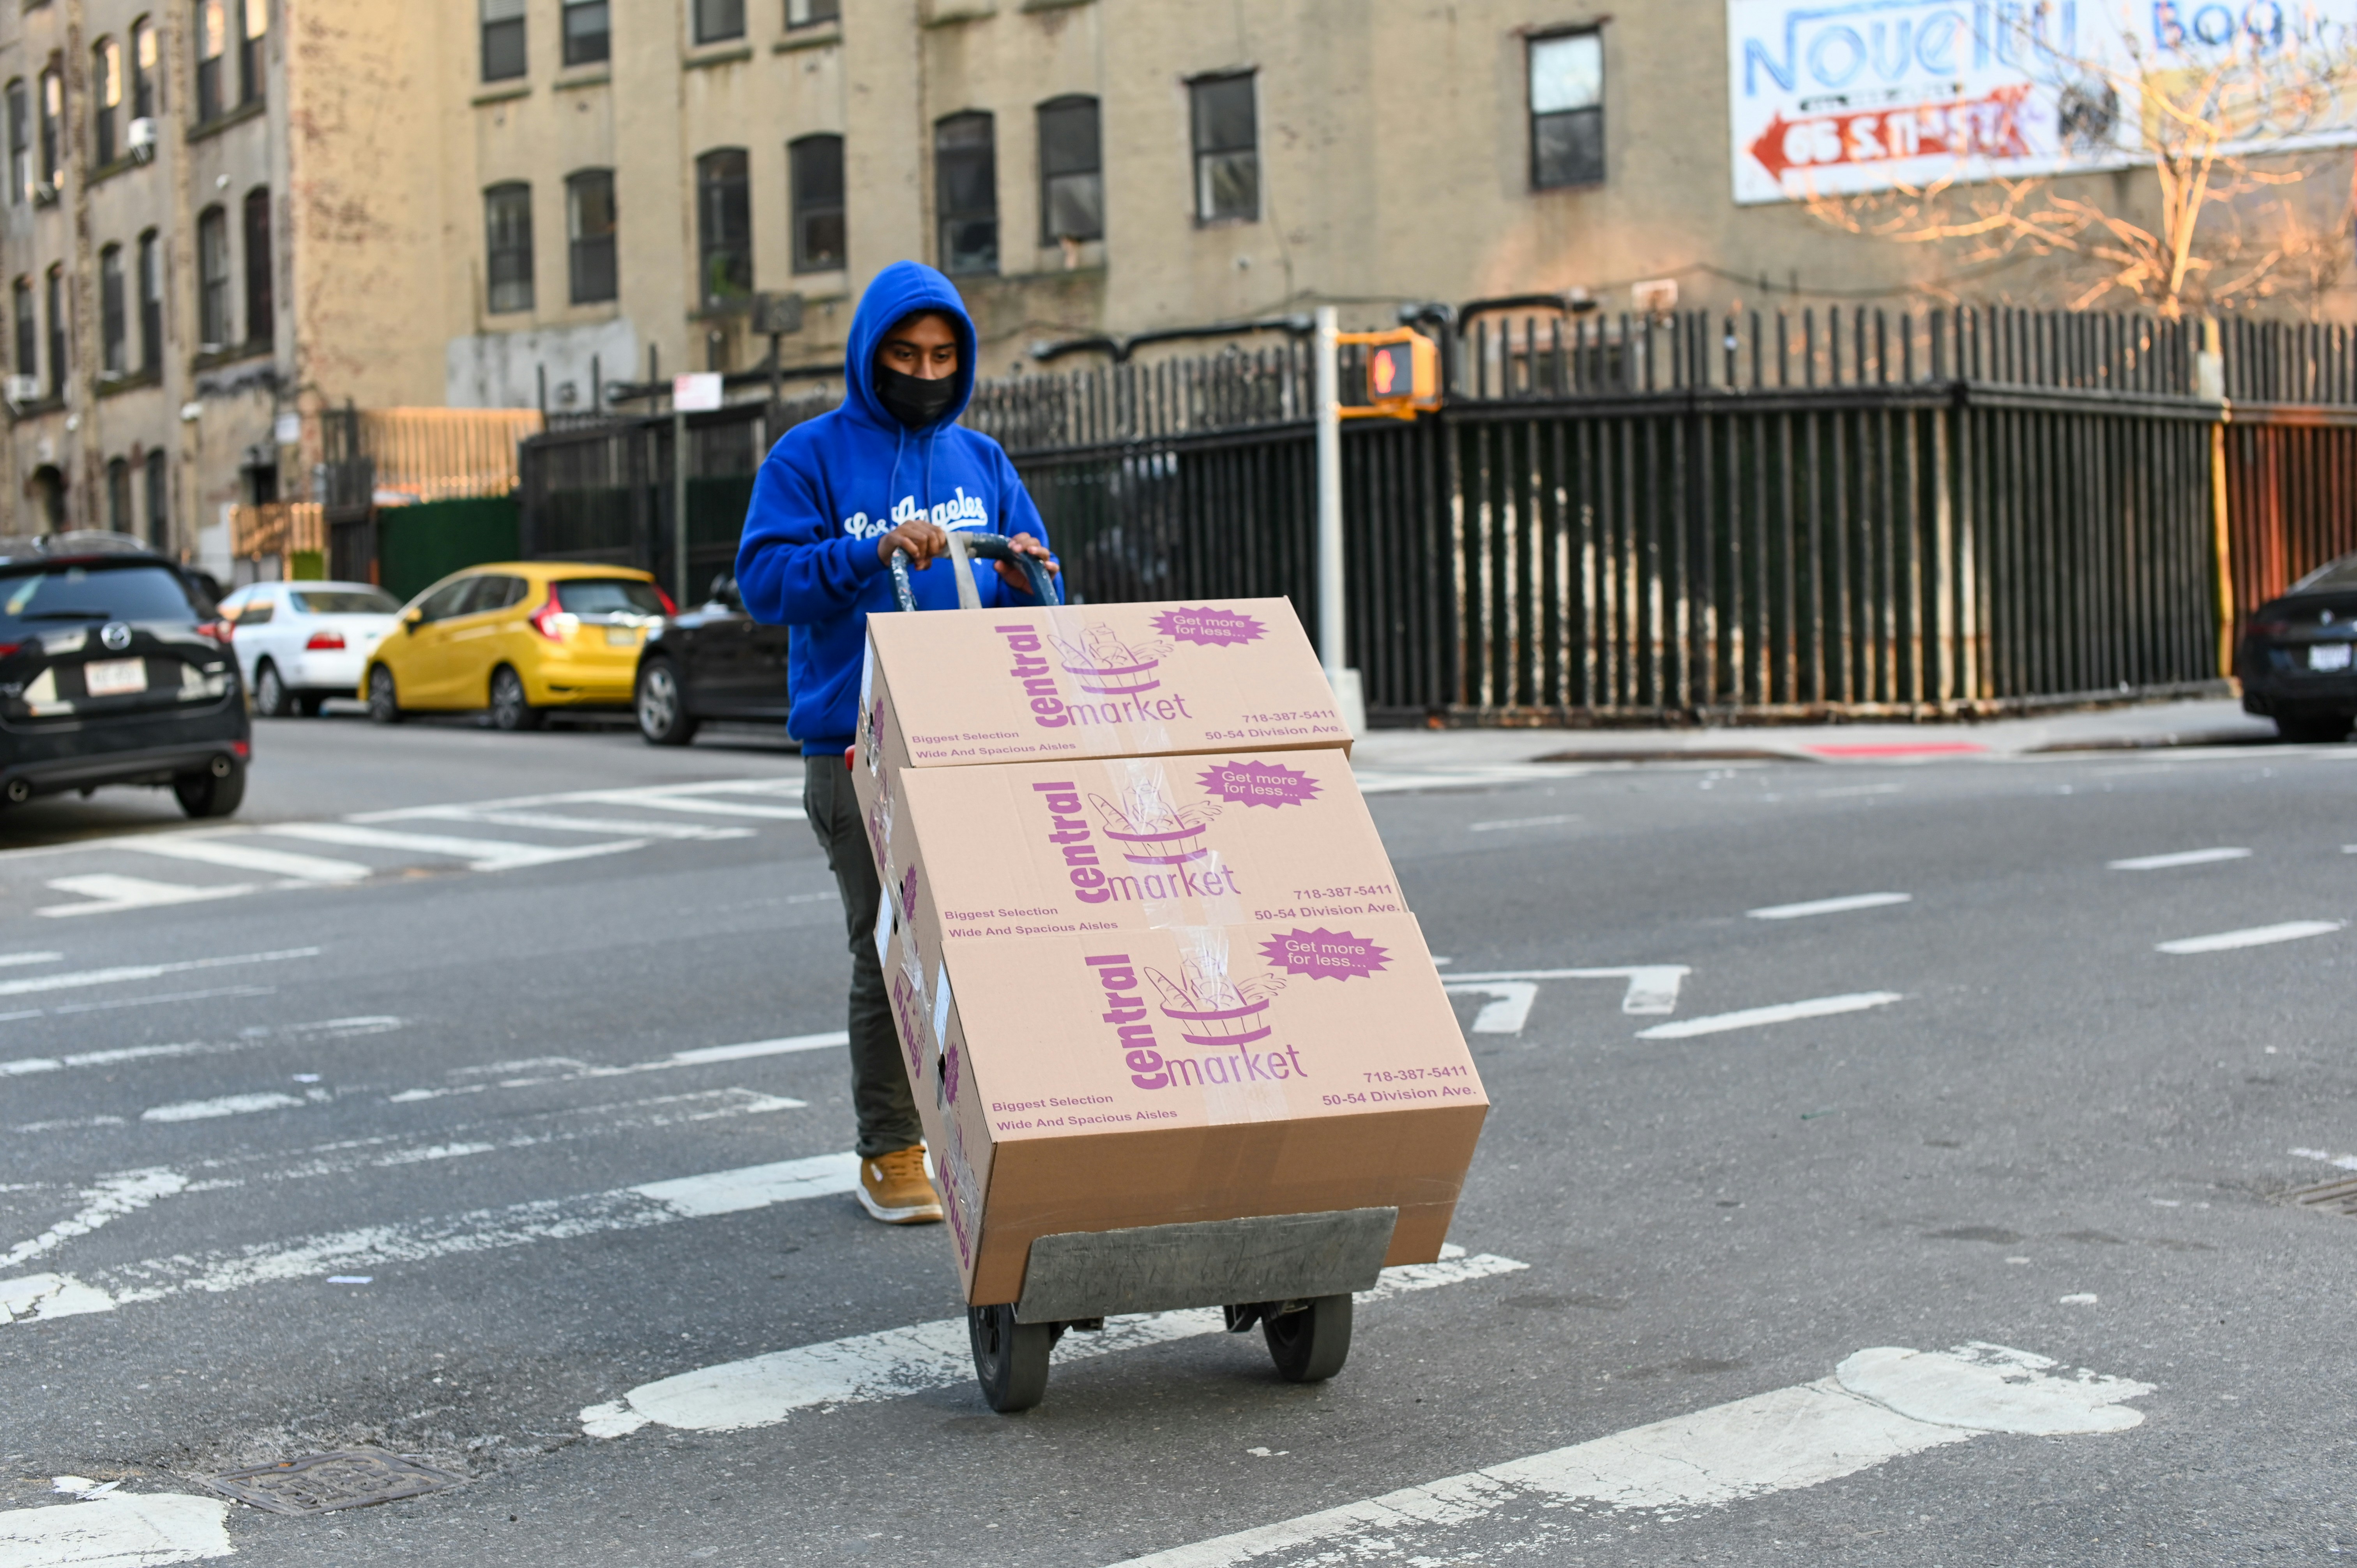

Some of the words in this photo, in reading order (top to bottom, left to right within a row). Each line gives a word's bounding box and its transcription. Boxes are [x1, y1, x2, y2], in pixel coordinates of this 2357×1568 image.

[844, 511, 890, 541] Los
[1173, 615, 1201, 625] Get
[1207, 619, 1245, 628] more
[1175, 625, 1196, 634] for
[1200, 627, 1246, 637] less...
[995, 625, 1069, 728] central
[1065, 692, 1193, 726] market
[1242, 710, 1335, 722] 718-387-5411
[912, 734, 958, 744] Biggest
[963, 731, 1019, 741] Selection
[1205, 730, 1245, 740] 50-54
[1248, 727, 1308, 737] Division
[1312, 725, 1343, 733] Ave.
[916, 749, 947, 758] Wide
[951, 748, 975, 756] And
[979, 745, 1035, 755] Spacious
[1039, 742, 1076, 750] Aisles
[1222, 771, 1251, 783] Get
[1256, 775, 1297, 785] more
[1223, 782, 1246, 793] for
[1251, 784, 1298, 797] less...
[1033, 782, 1111, 904] central
[1107, 862, 1241, 901] market
[1293, 884, 1392, 900] 718-387-5411
[945, 909, 995, 920] Biggest
[998, 907, 1058, 917] Selection
[1254, 909, 1296, 920] 50-54
[1300, 905, 1363, 917] Division
[1368, 903, 1400, 913] Ave.
[949, 929, 982, 938] Wide
[986, 926, 1012, 936] And
[1015, 924, 1076, 935] Spacious
[1079, 922, 1118, 930] Aisles
[1285, 940, 1317, 952] Get
[1322, 944, 1365, 955] more
[1287, 952, 1310, 964] for
[1316, 954, 1366, 968] less...
[1085, 954, 1169, 1090] central
[1165, 1042, 1308, 1086] market
[1363, 1065, 1467, 1083] 718-387-5411
[992, 1100, 1046, 1112] Biggest
[1050, 1095, 1113, 1106] Selection
[1322, 1093, 1367, 1105] 50-54
[1371, 1089, 1437, 1102] Division
[1442, 1086, 1476, 1097] Ave.
[997, 1120, 1032, 1130] Wide
[1037, 1118, 1064, 1127] And
[1068, 1113, 1132, 1126] Spacious
[1136, 1110, 1178, 1120] Aisles
